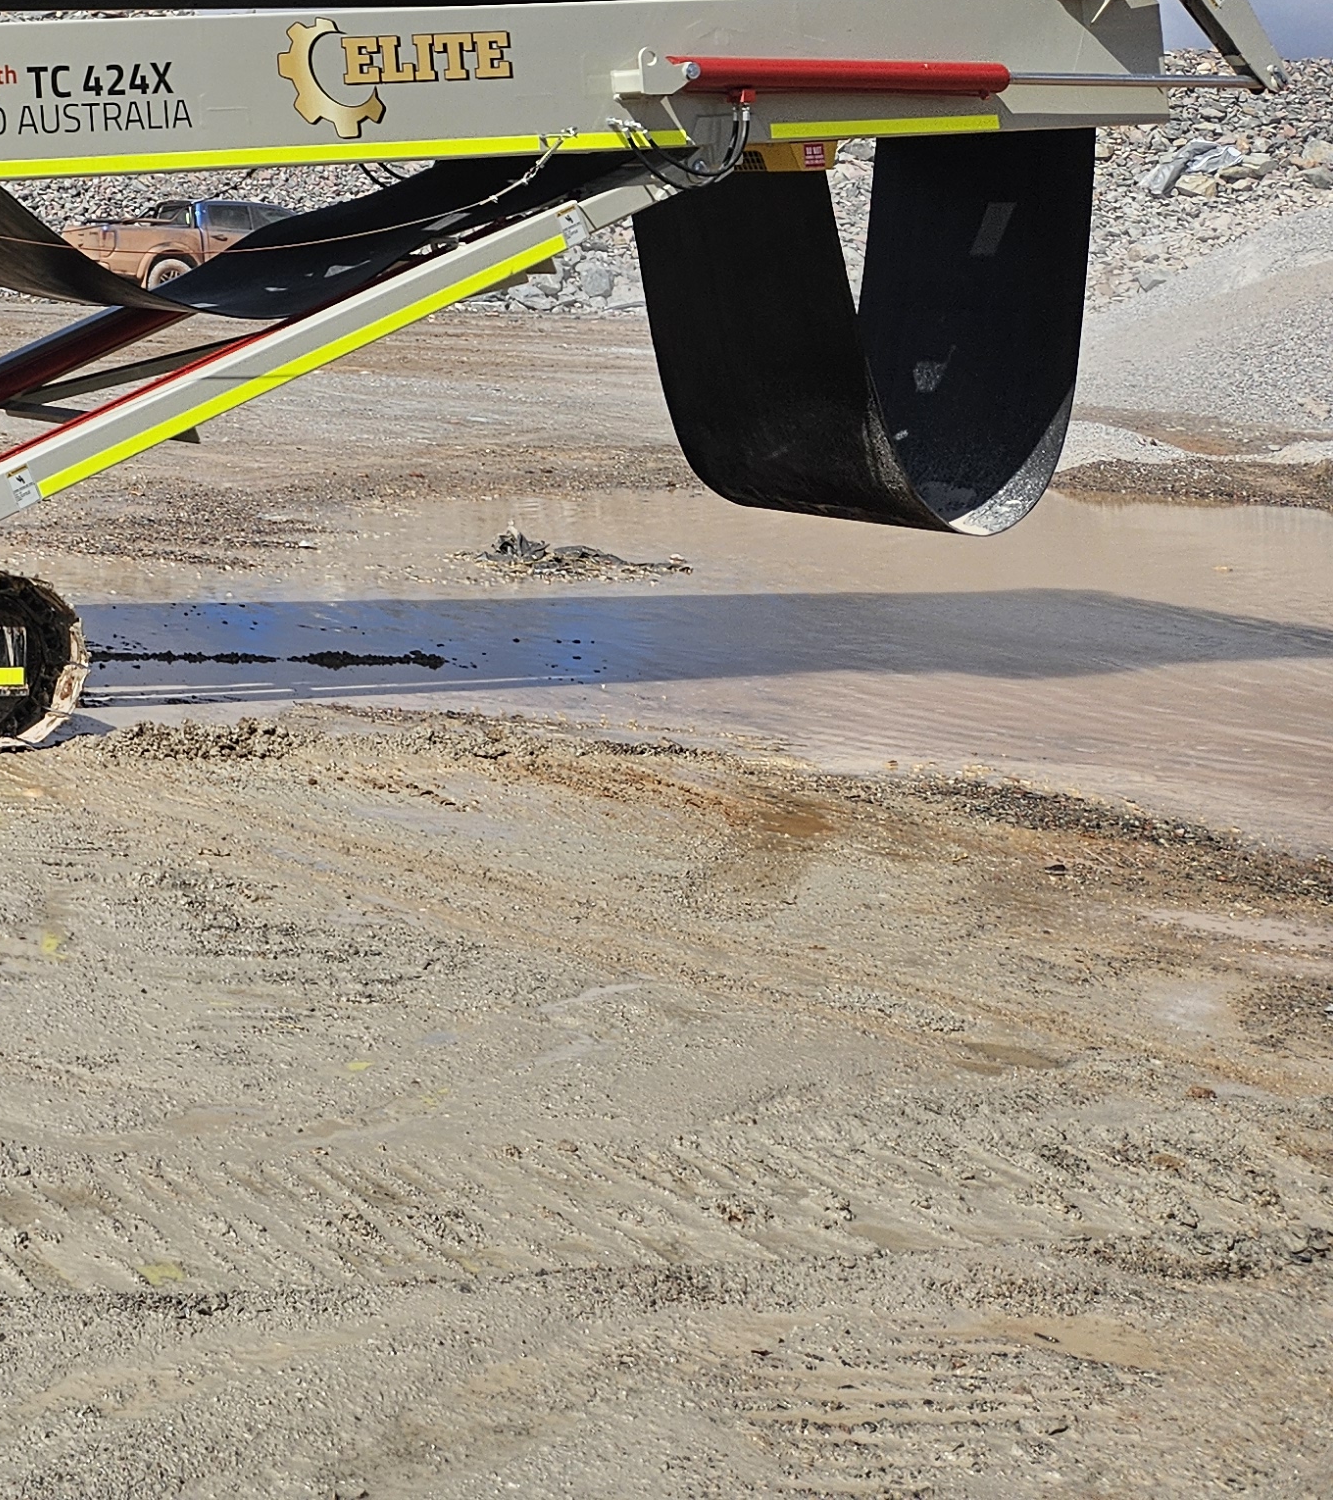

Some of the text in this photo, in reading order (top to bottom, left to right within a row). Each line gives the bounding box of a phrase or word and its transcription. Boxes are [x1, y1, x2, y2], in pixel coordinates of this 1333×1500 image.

[26, 64, 72, 99] TC
[81, 61, 176, 97] 424X
[17, 98, 193, 135] AUSTRALIA
